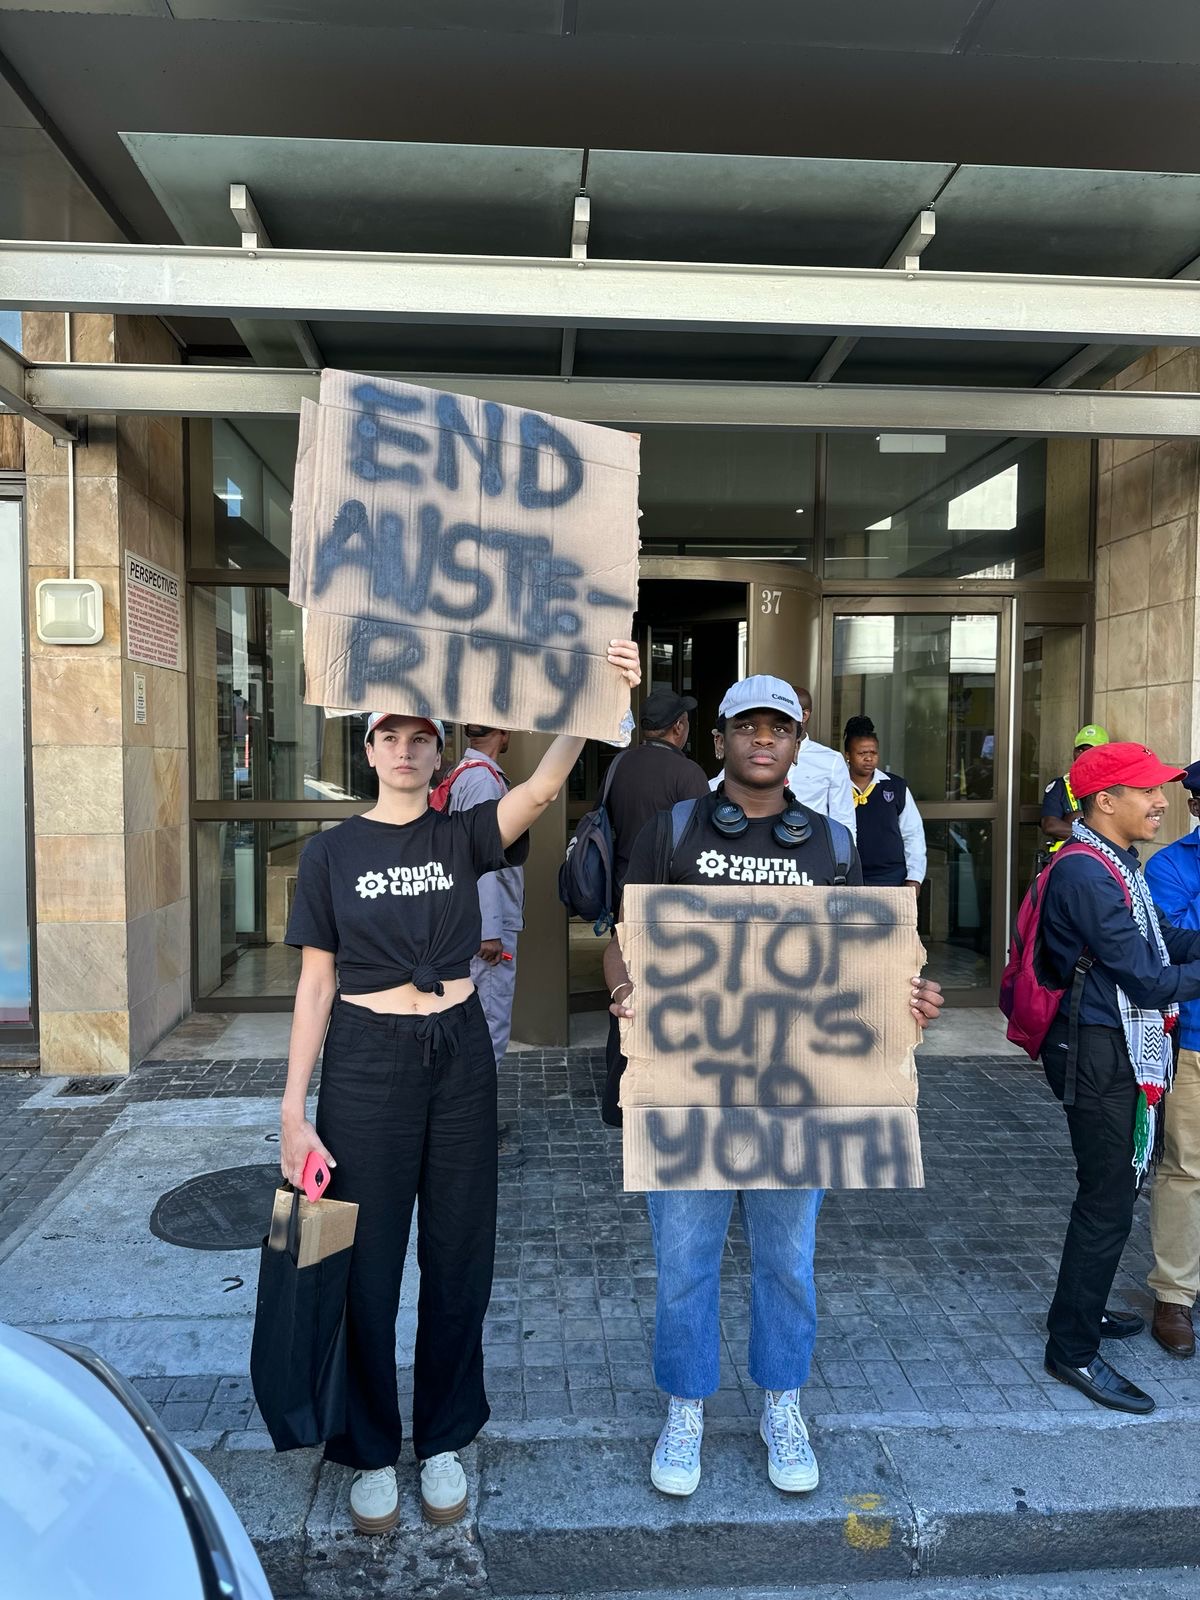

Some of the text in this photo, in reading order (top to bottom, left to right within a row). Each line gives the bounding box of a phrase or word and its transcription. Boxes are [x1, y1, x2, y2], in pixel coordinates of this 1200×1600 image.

[351, 383, 585, 509] END
[130, 561, 178, 597] PERSPECTIVES
[761, 589, 782, 615] 37
[771, 693, 794, 706] Canon
[387, 861, 445, 881] YOUTH
[729, 854, 797, 872] YOUTH
[729, 866, 814, 886] CAPITAL
[389, 873, 454, 896] CAPITAL
[645, 886, 898, 992] STOP
[648, 991, 876, 1062] CUTS
[693, 1057, 818, 1119] TO
[645, 1106, 910, 1190] YOUTH
